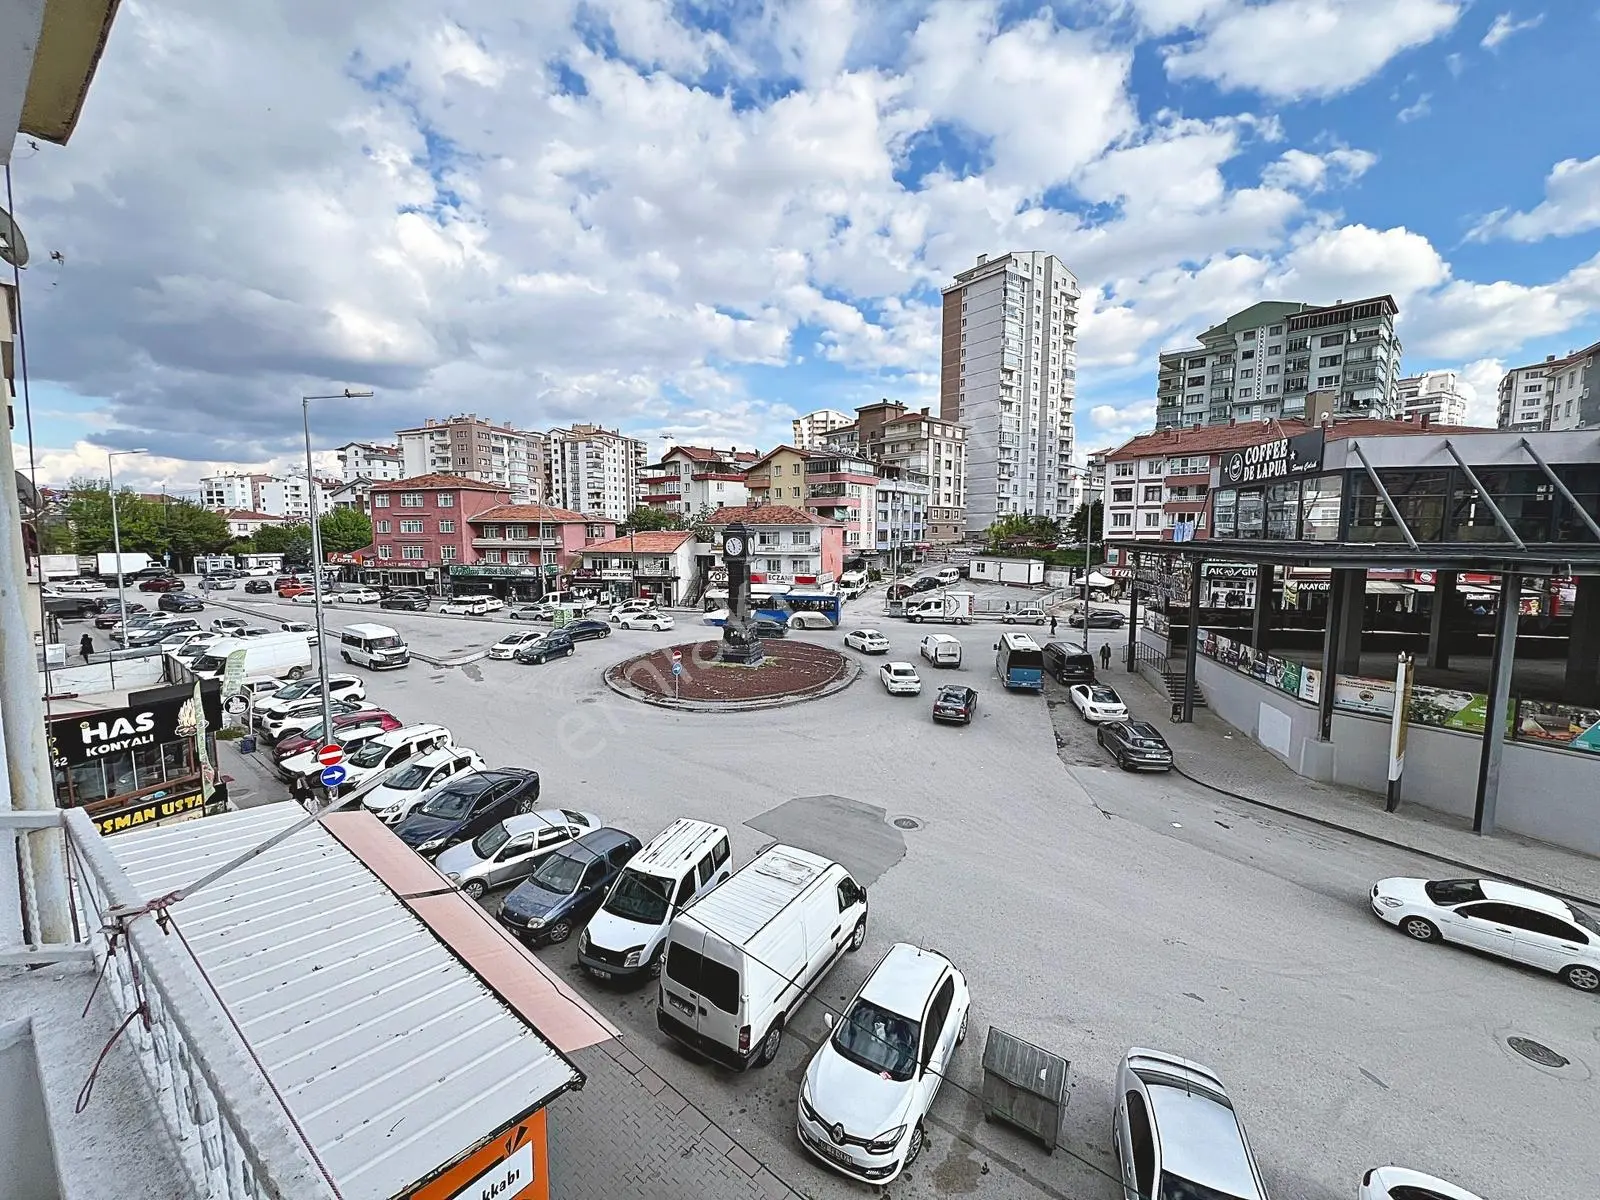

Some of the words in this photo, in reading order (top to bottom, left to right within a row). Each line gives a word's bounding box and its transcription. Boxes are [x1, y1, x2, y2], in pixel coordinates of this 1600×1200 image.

[1245, 438, 1288, 465] COFFEE
[1243, 464, 1255, 482] DE
[1256, 459, 1288, 480] LAPUA
[81, 711, 155, 744] HAS
[85, 734, 154, 757] KONYALI
[161, 793, 203, 815] USTA
